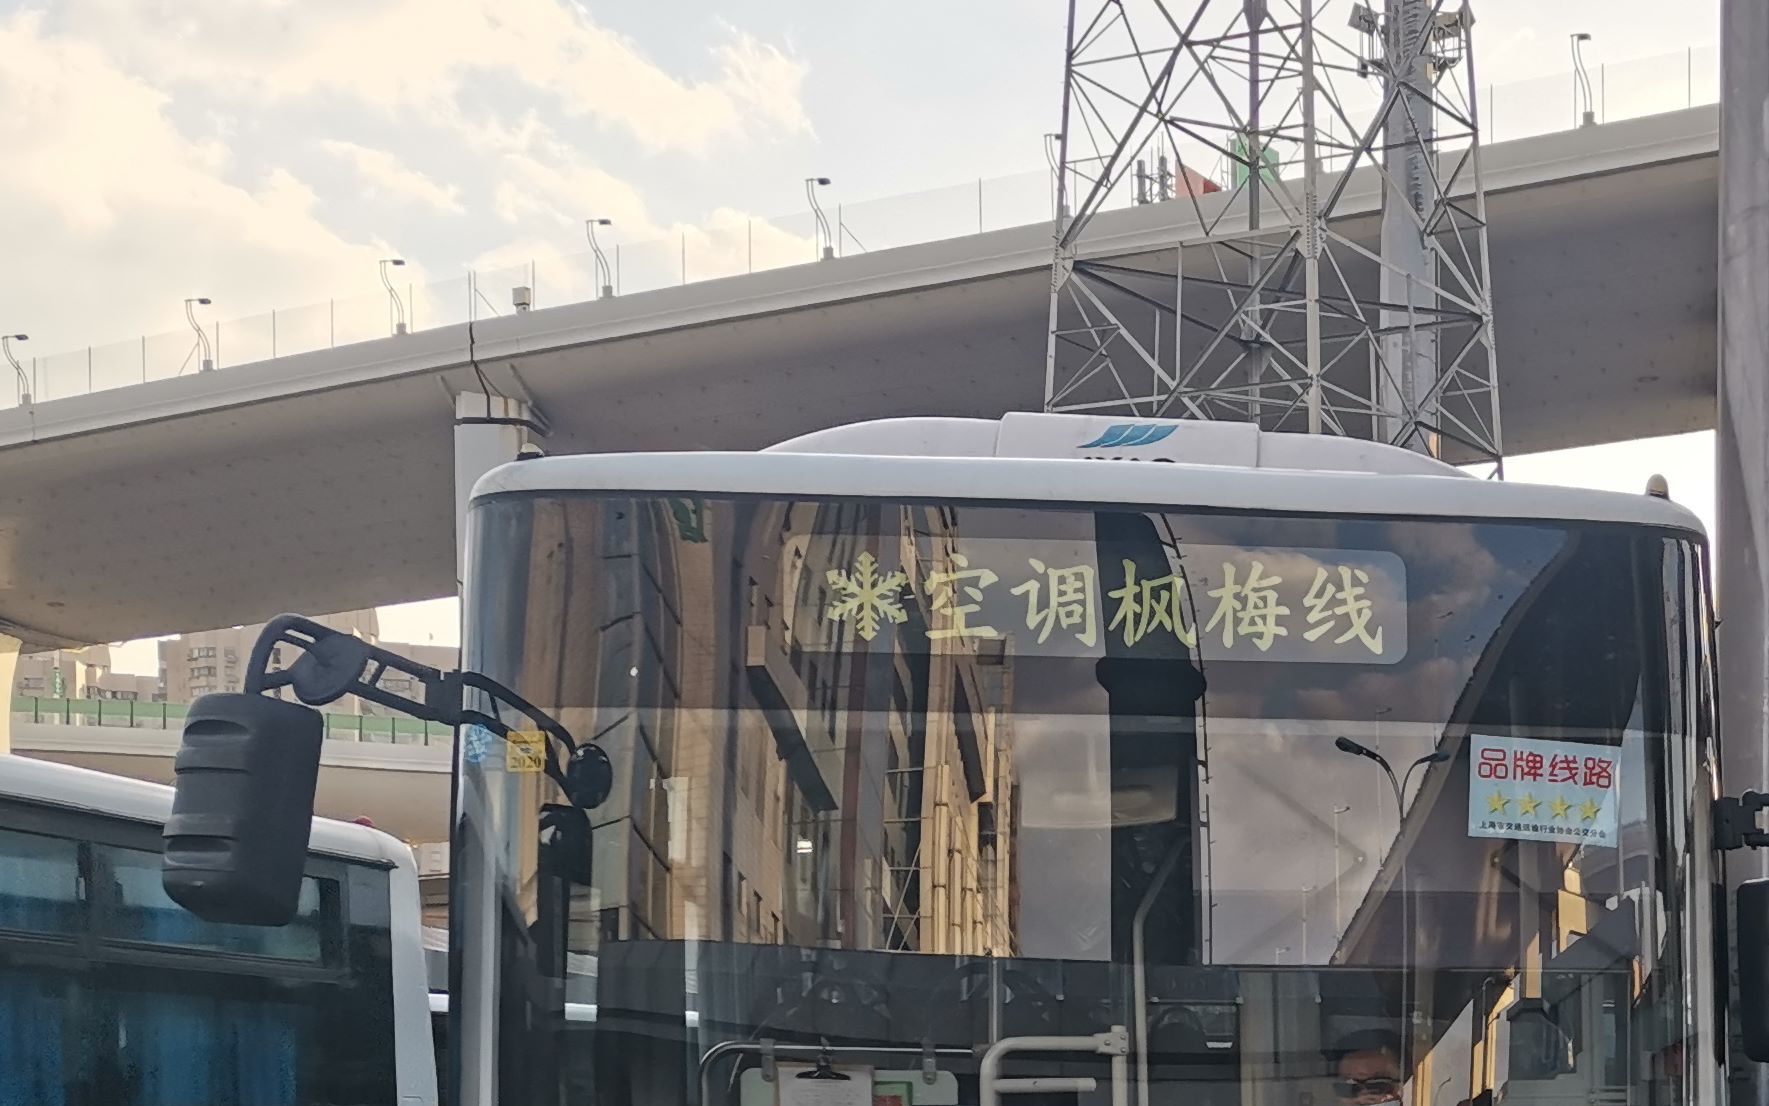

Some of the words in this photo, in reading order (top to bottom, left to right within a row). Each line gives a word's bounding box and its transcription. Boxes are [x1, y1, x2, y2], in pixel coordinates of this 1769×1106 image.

[925, 554, 1385, 656] 空调枫梅线
[1477, 747, 1613, 789] 品牌线路
